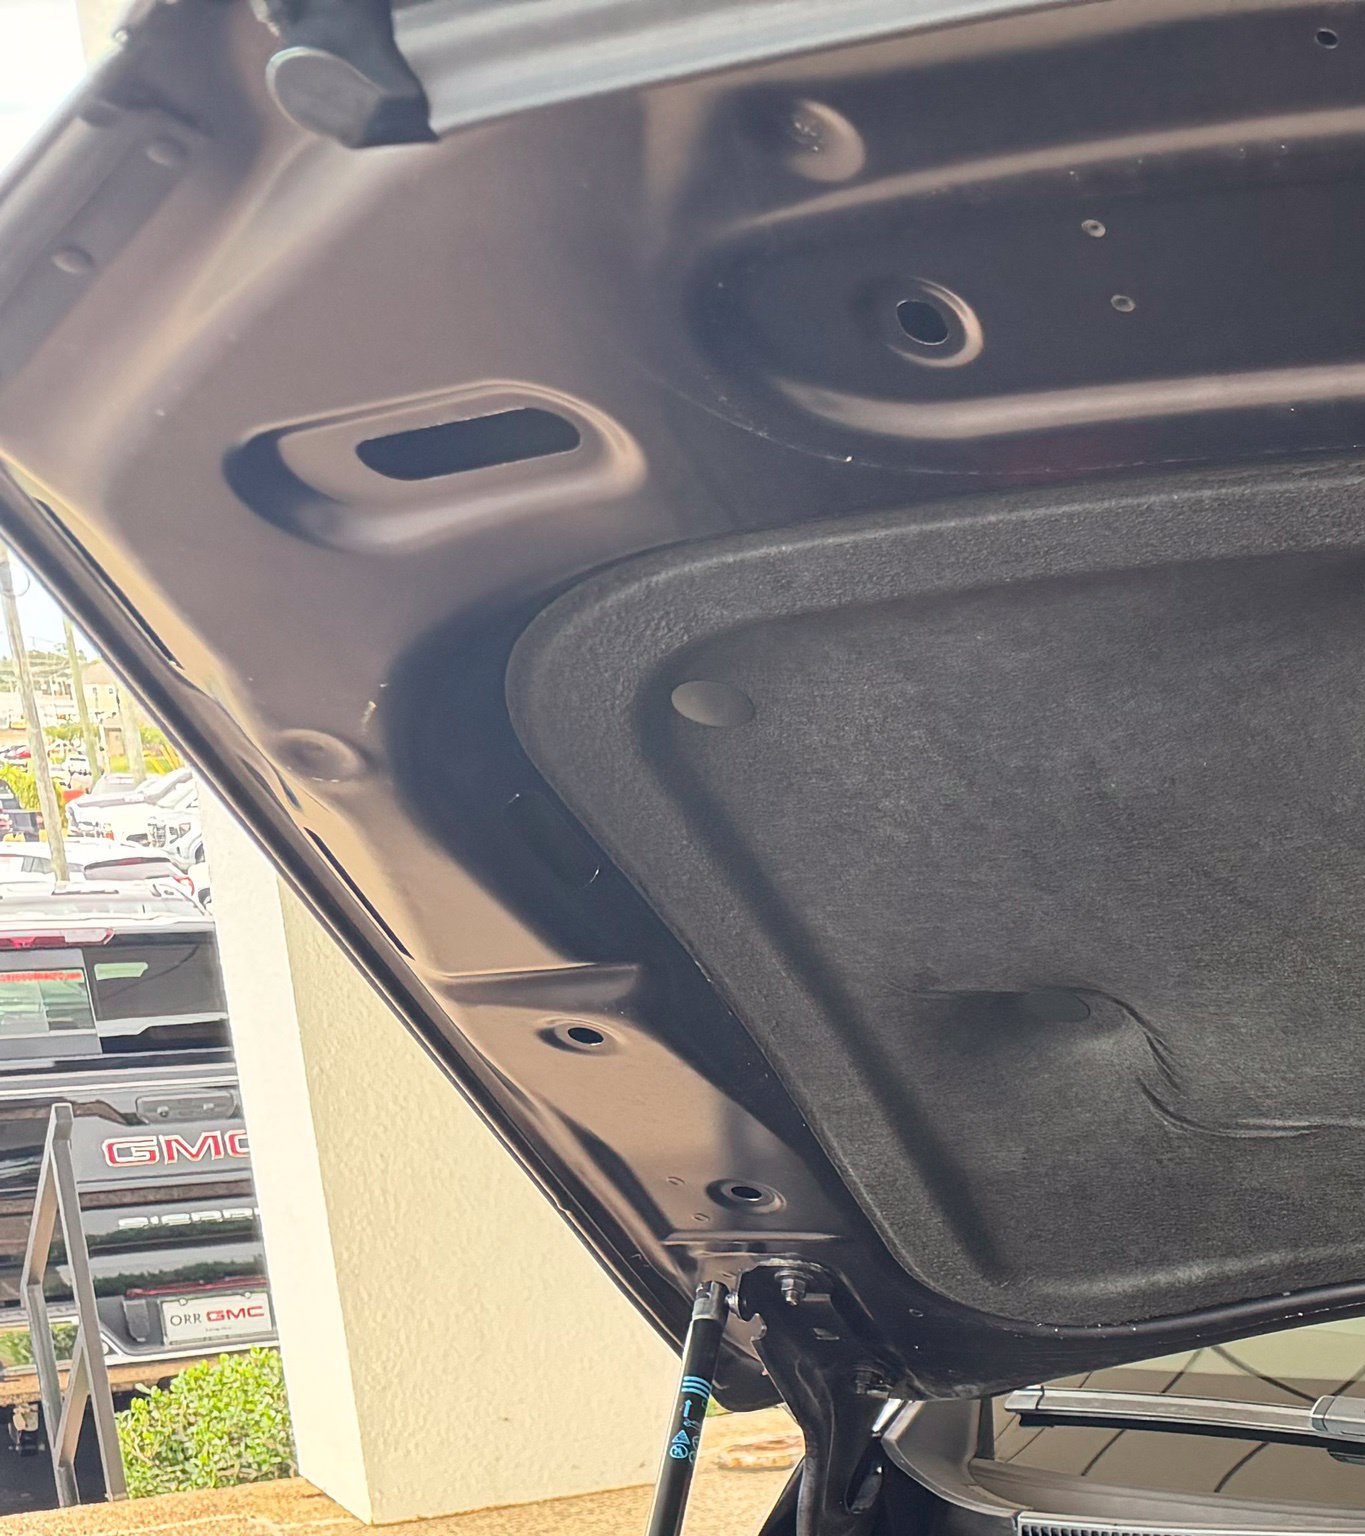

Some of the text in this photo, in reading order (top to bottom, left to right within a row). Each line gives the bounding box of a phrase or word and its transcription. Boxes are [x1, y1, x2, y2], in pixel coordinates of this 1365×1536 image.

[118, 1207, 260, 1230] SIERR
[170, 1306, 265, 1326] ORR GMC
